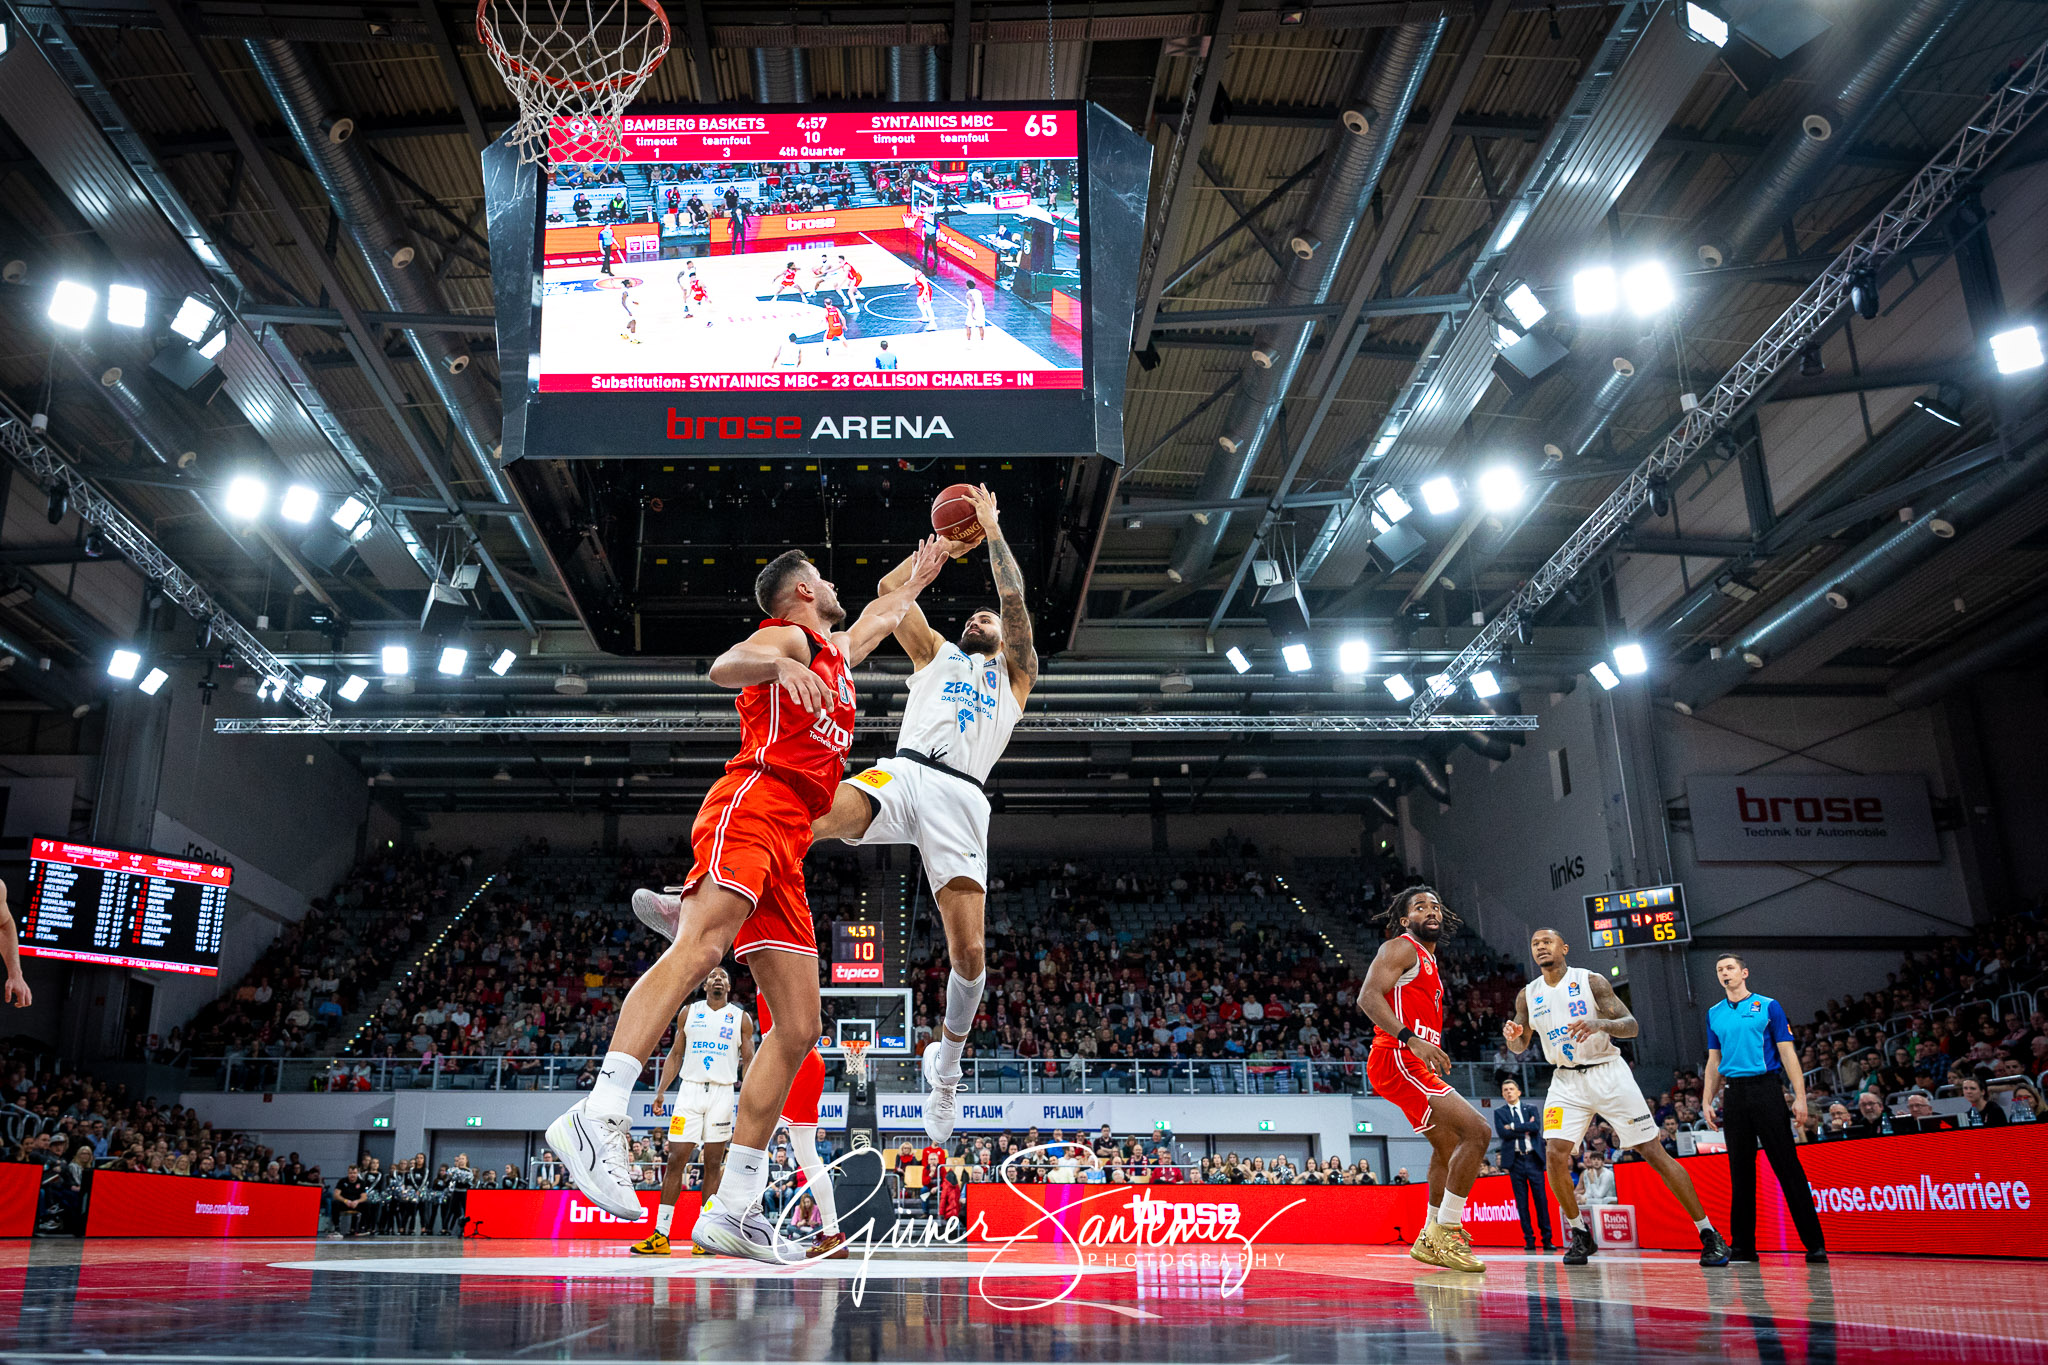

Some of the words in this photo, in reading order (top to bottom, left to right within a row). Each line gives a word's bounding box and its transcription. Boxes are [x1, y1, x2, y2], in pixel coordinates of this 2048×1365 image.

[624, 118, 696, 132] BAMBERG
[699, 117, 766, 131] BASKETS
[796, 116, 828, 129] 4:57
[871, 115, 958, 128] SYNTAINICS
[961, 115, 993, 127] MBC
[1024, 114, 1058, 137] 65
[635, 136, 678, 147] timeout
[702, 135, 751, 146] teamfoul
[804, 131, 821, 144] 10
[873, 134, 916, 144] timeout
[940, 132, 990, 144] teamfoul
[653, 147, 660, 159] 1
[722, 147, 731, 158] 3
[778, 146, 798, 157] 4th
[800, 146, 846, 157] Quarter
[891, 145, 898, 156] 1
[962, 144, 968, 155] 1
[786, 216, 836, 231] brose
[591, 376, 686, 389] Substitution:
[689, 375, 780, 388] SYNTAINICS
[784, 374, 819, 388] MBC
[831, 374, 850, 387] 23
[853, 373, 928, 387] CALLISON
[932, 373, 1002, 387] CHARLES
[1017, 372, 1034, 386] IN
[666, 407, 802, 440] brose
[810, 415, 955, 440] ARENA
[980, 693, 996, 708] UP
[1735, 786, 1885, 823] brose
[1743, 827, 1792, 838] Technik
[1795, 827, 1811, 837] für
[1816, 827, 1888, 838] Automobile
[40, 840, 55, 853] 91
[210, 867, 225, 878] 65
[1550, 854, 1585, 891] links
[1630, 913, 1642, 927] 4
[1655, 911, 1674, 923] MBC
[847, 925, 876, 938] 4.57
[1602, 929, 1624, 947] 91
[1652, 922, 1677, 941] 65
[854, 942, 875, 961] 10
[835, 965, 880, 980] tipico
[1568, 999, 1588, 1017] 23
[719, 1026, 734, 1040] 22
[692, 1041, 716, 1050] ZERO
[717, 1042, 729, 1051] UP
[882, 1104, 923, 1118] PFLAUM
[963, 1104, 1003, 1119] PFLAUM
[1043, 1105, 1084, 1119] PFLAUM
[1132, 1194, 1240, 1225] brose
[1473, 1200, 1521, 1222] Automobil
[1603, 1212, 1628, 1224] RHÖN
